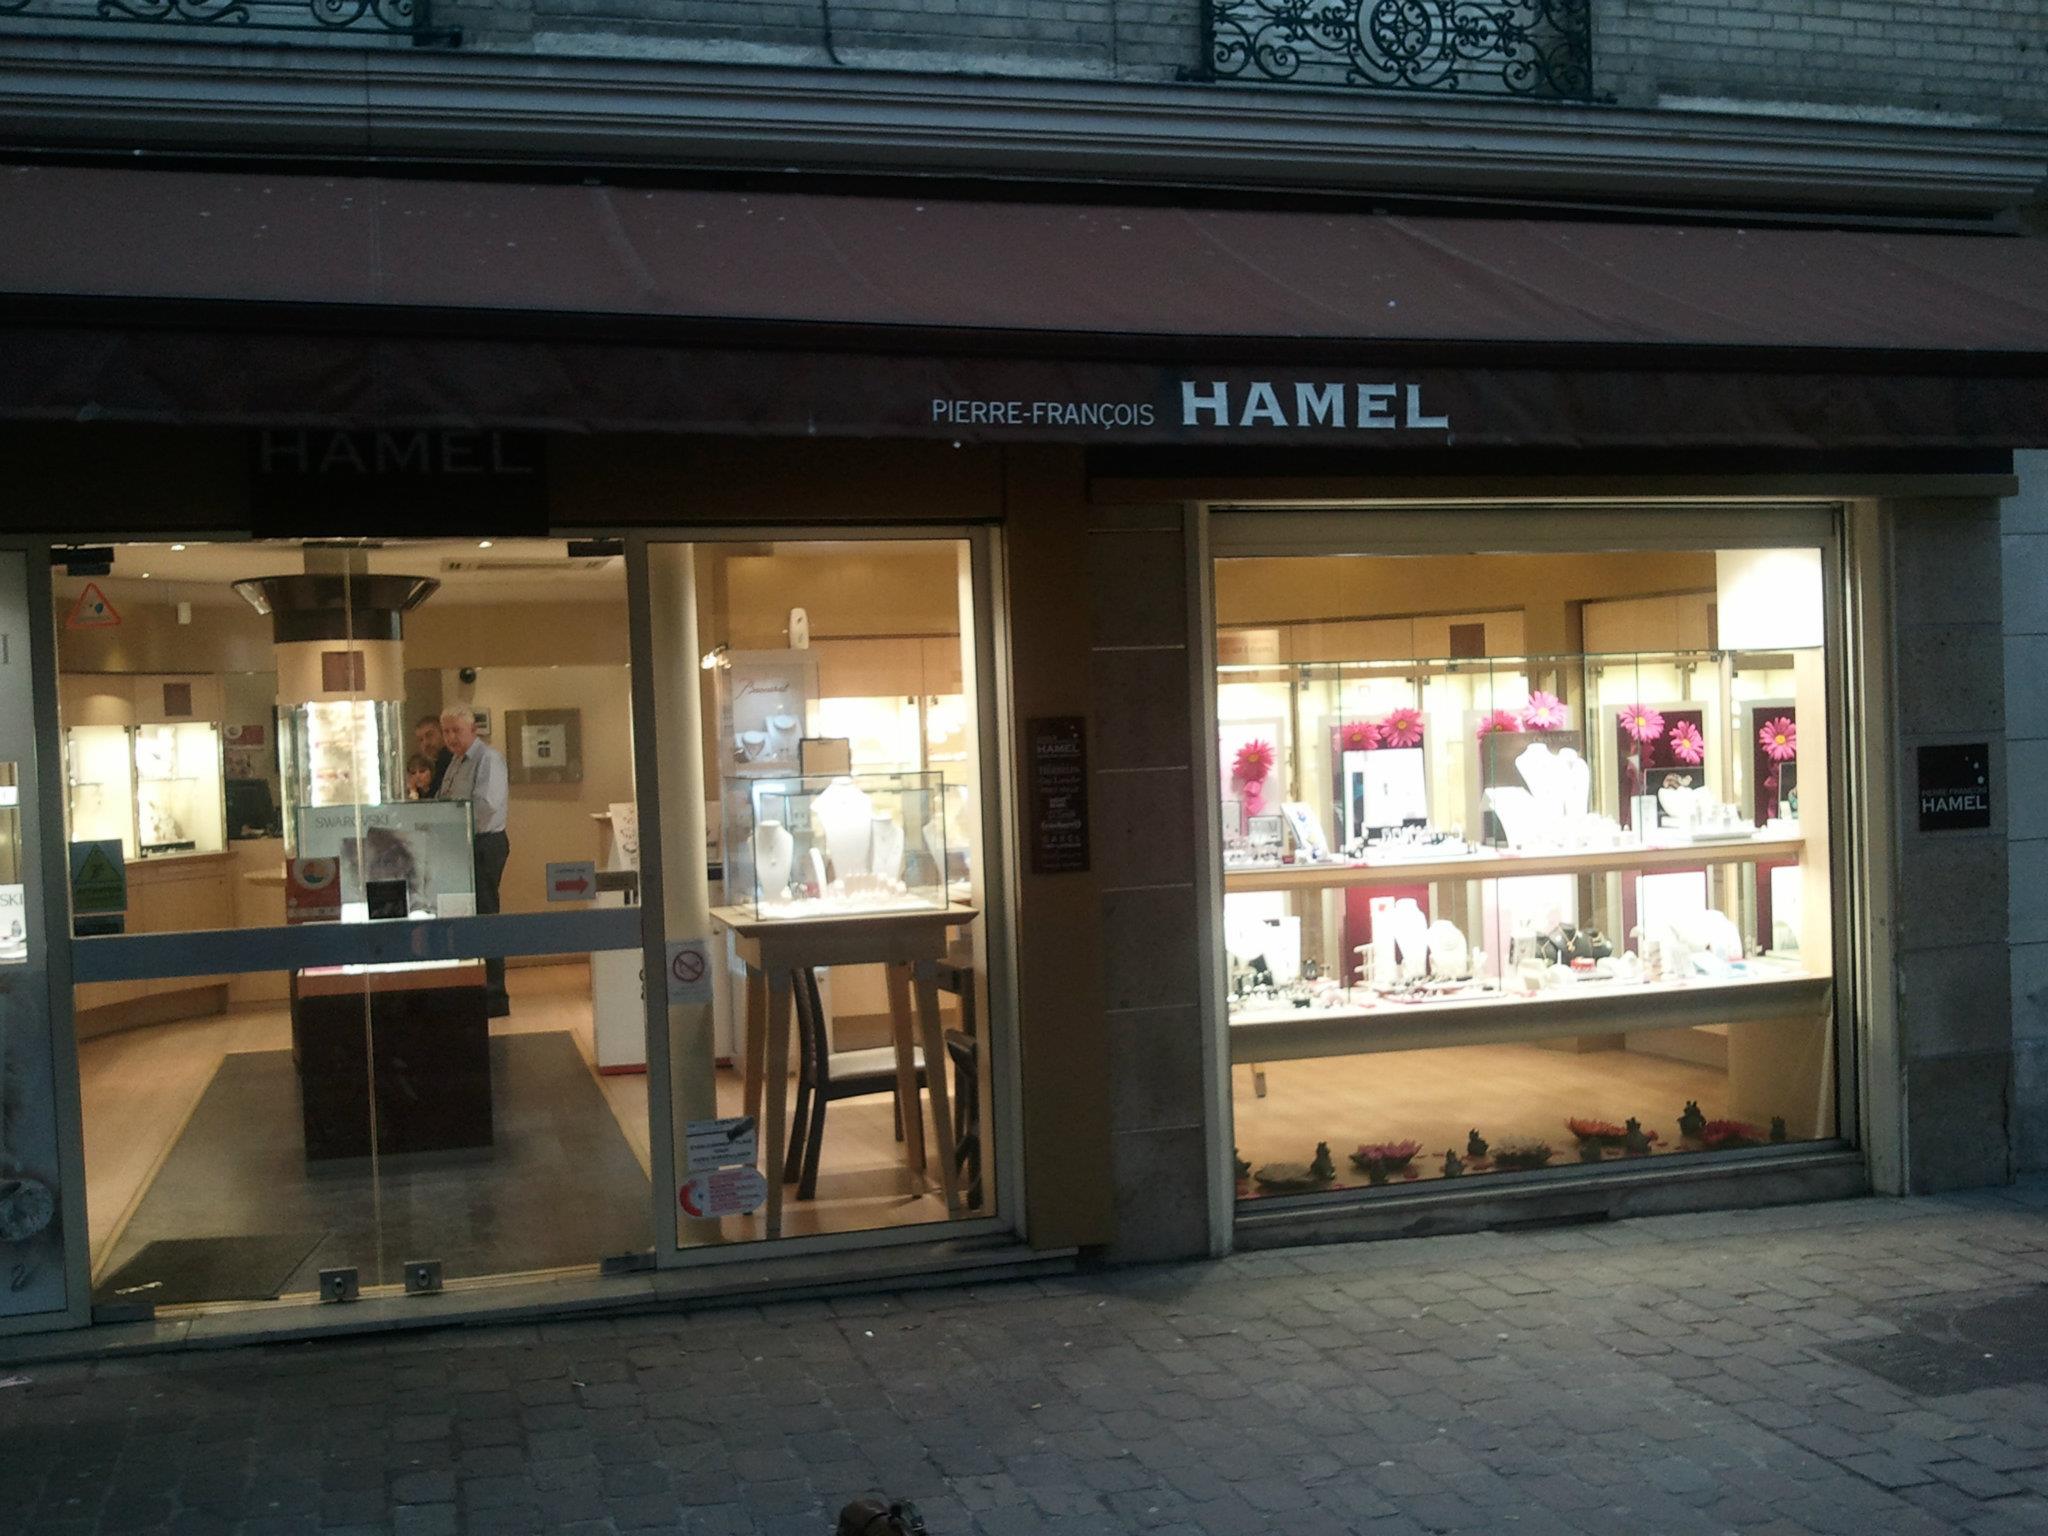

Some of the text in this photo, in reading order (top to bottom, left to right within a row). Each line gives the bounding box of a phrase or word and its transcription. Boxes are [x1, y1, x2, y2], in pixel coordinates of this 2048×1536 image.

[932, 381, 1449, 429] PIERRE-FRANÇOIS HAMEL
[261, 430, 533, 473] HAMEL
[1036, 743, 1080, 754] HAMEL
[1922, 795, 1987, 813] HAMEL
[315, 814, 389, 828] SWARVSKI
